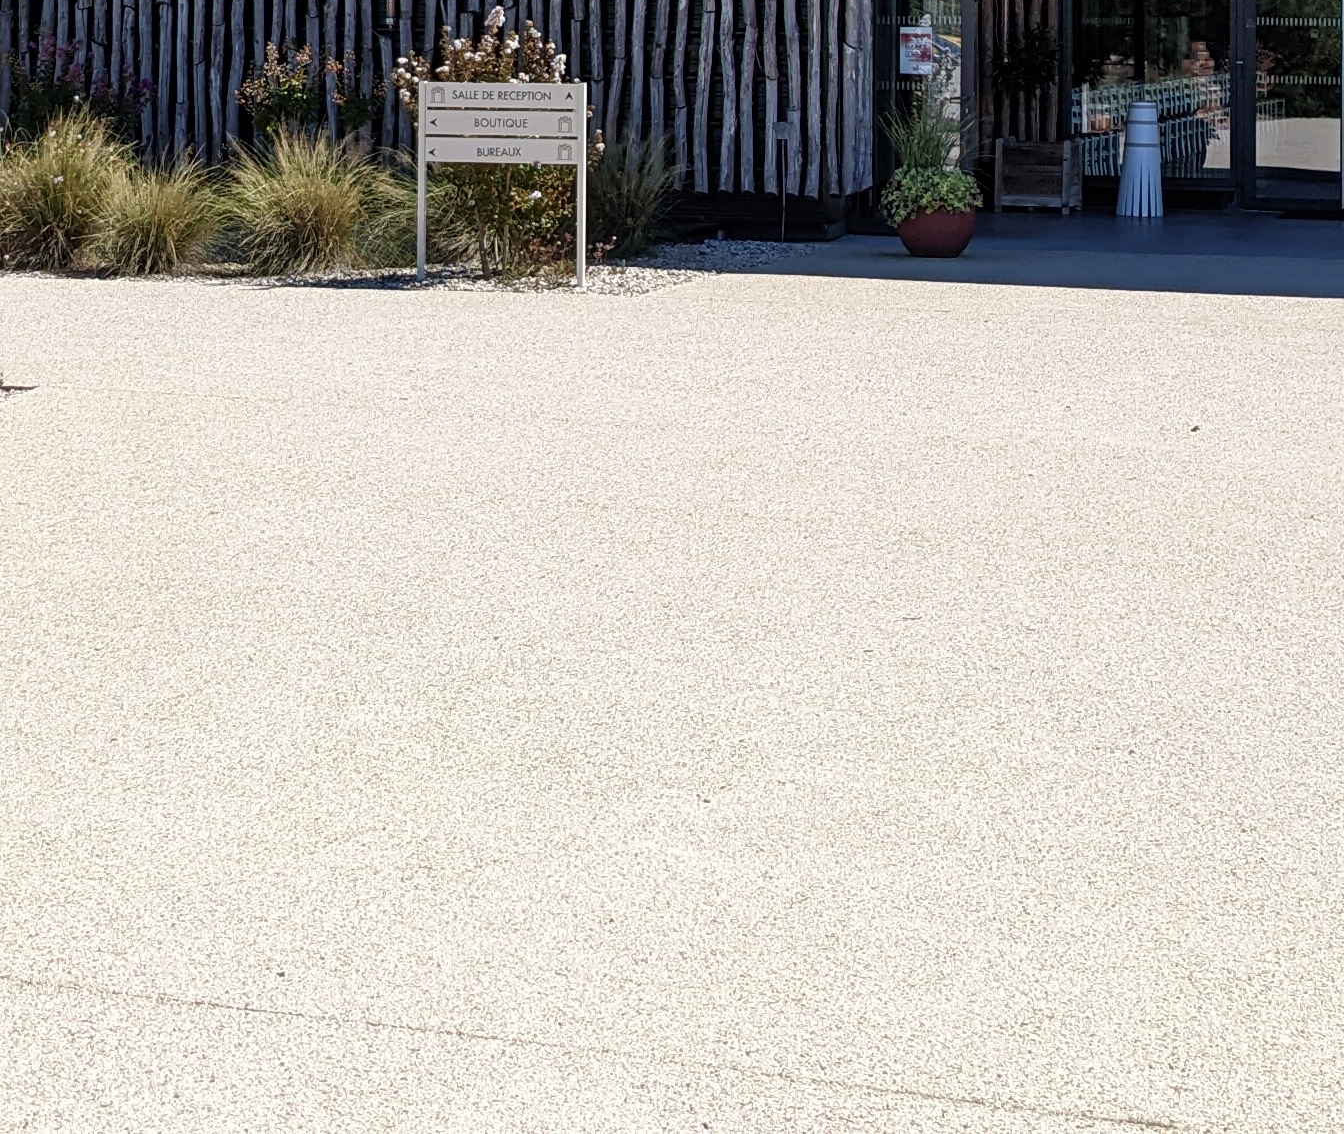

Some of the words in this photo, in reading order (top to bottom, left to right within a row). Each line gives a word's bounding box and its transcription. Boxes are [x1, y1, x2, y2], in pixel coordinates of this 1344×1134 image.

[452, 90, 479, 100] SALLE
[482, 91, 494, 101] DE
[498, 91, 551, 101] RECEPTION
[474, 118, 528, 128] BOUTIQUE
[477, 147, 522, 157] BUREAUX
